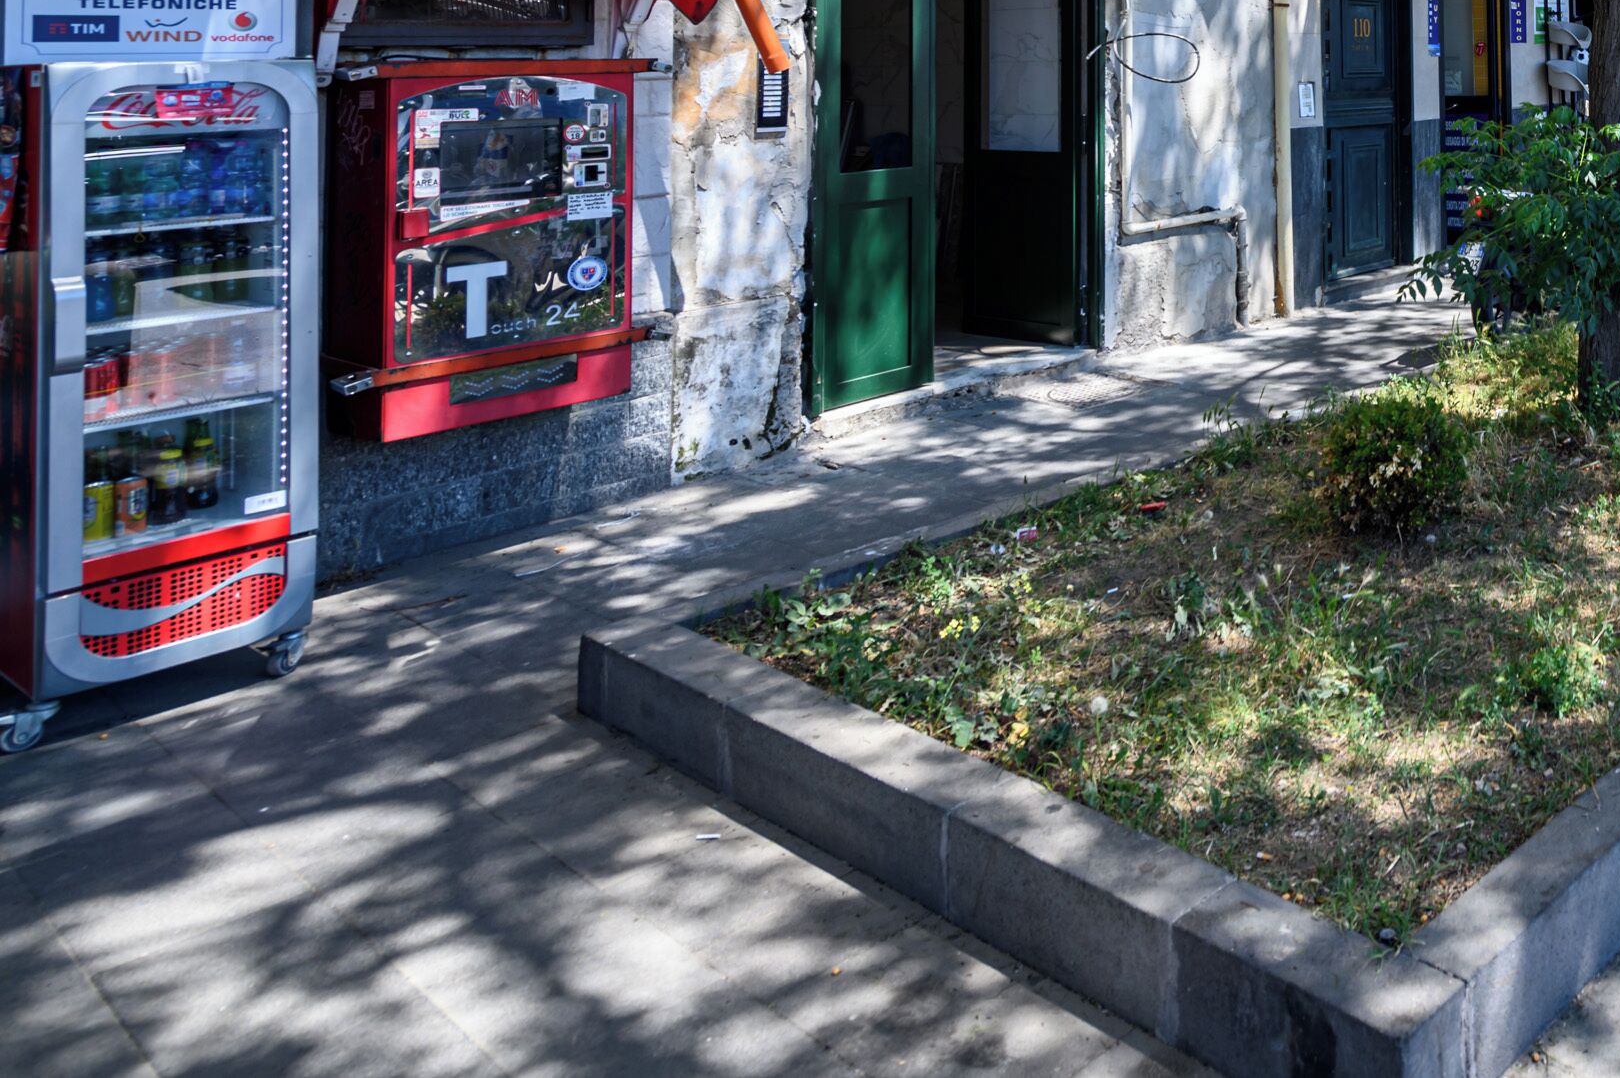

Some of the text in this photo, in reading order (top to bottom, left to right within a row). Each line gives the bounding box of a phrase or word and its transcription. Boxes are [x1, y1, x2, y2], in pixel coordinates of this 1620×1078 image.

[70, 23, 105, 35] TIM
[1353, 18, 1371, 38] 110
[126, 29, 203, 43] WIND
[211, 33, 274, 43] vodafone
[416, 179, 438, 188] AREA
[545, 302, 581, 326] 24
